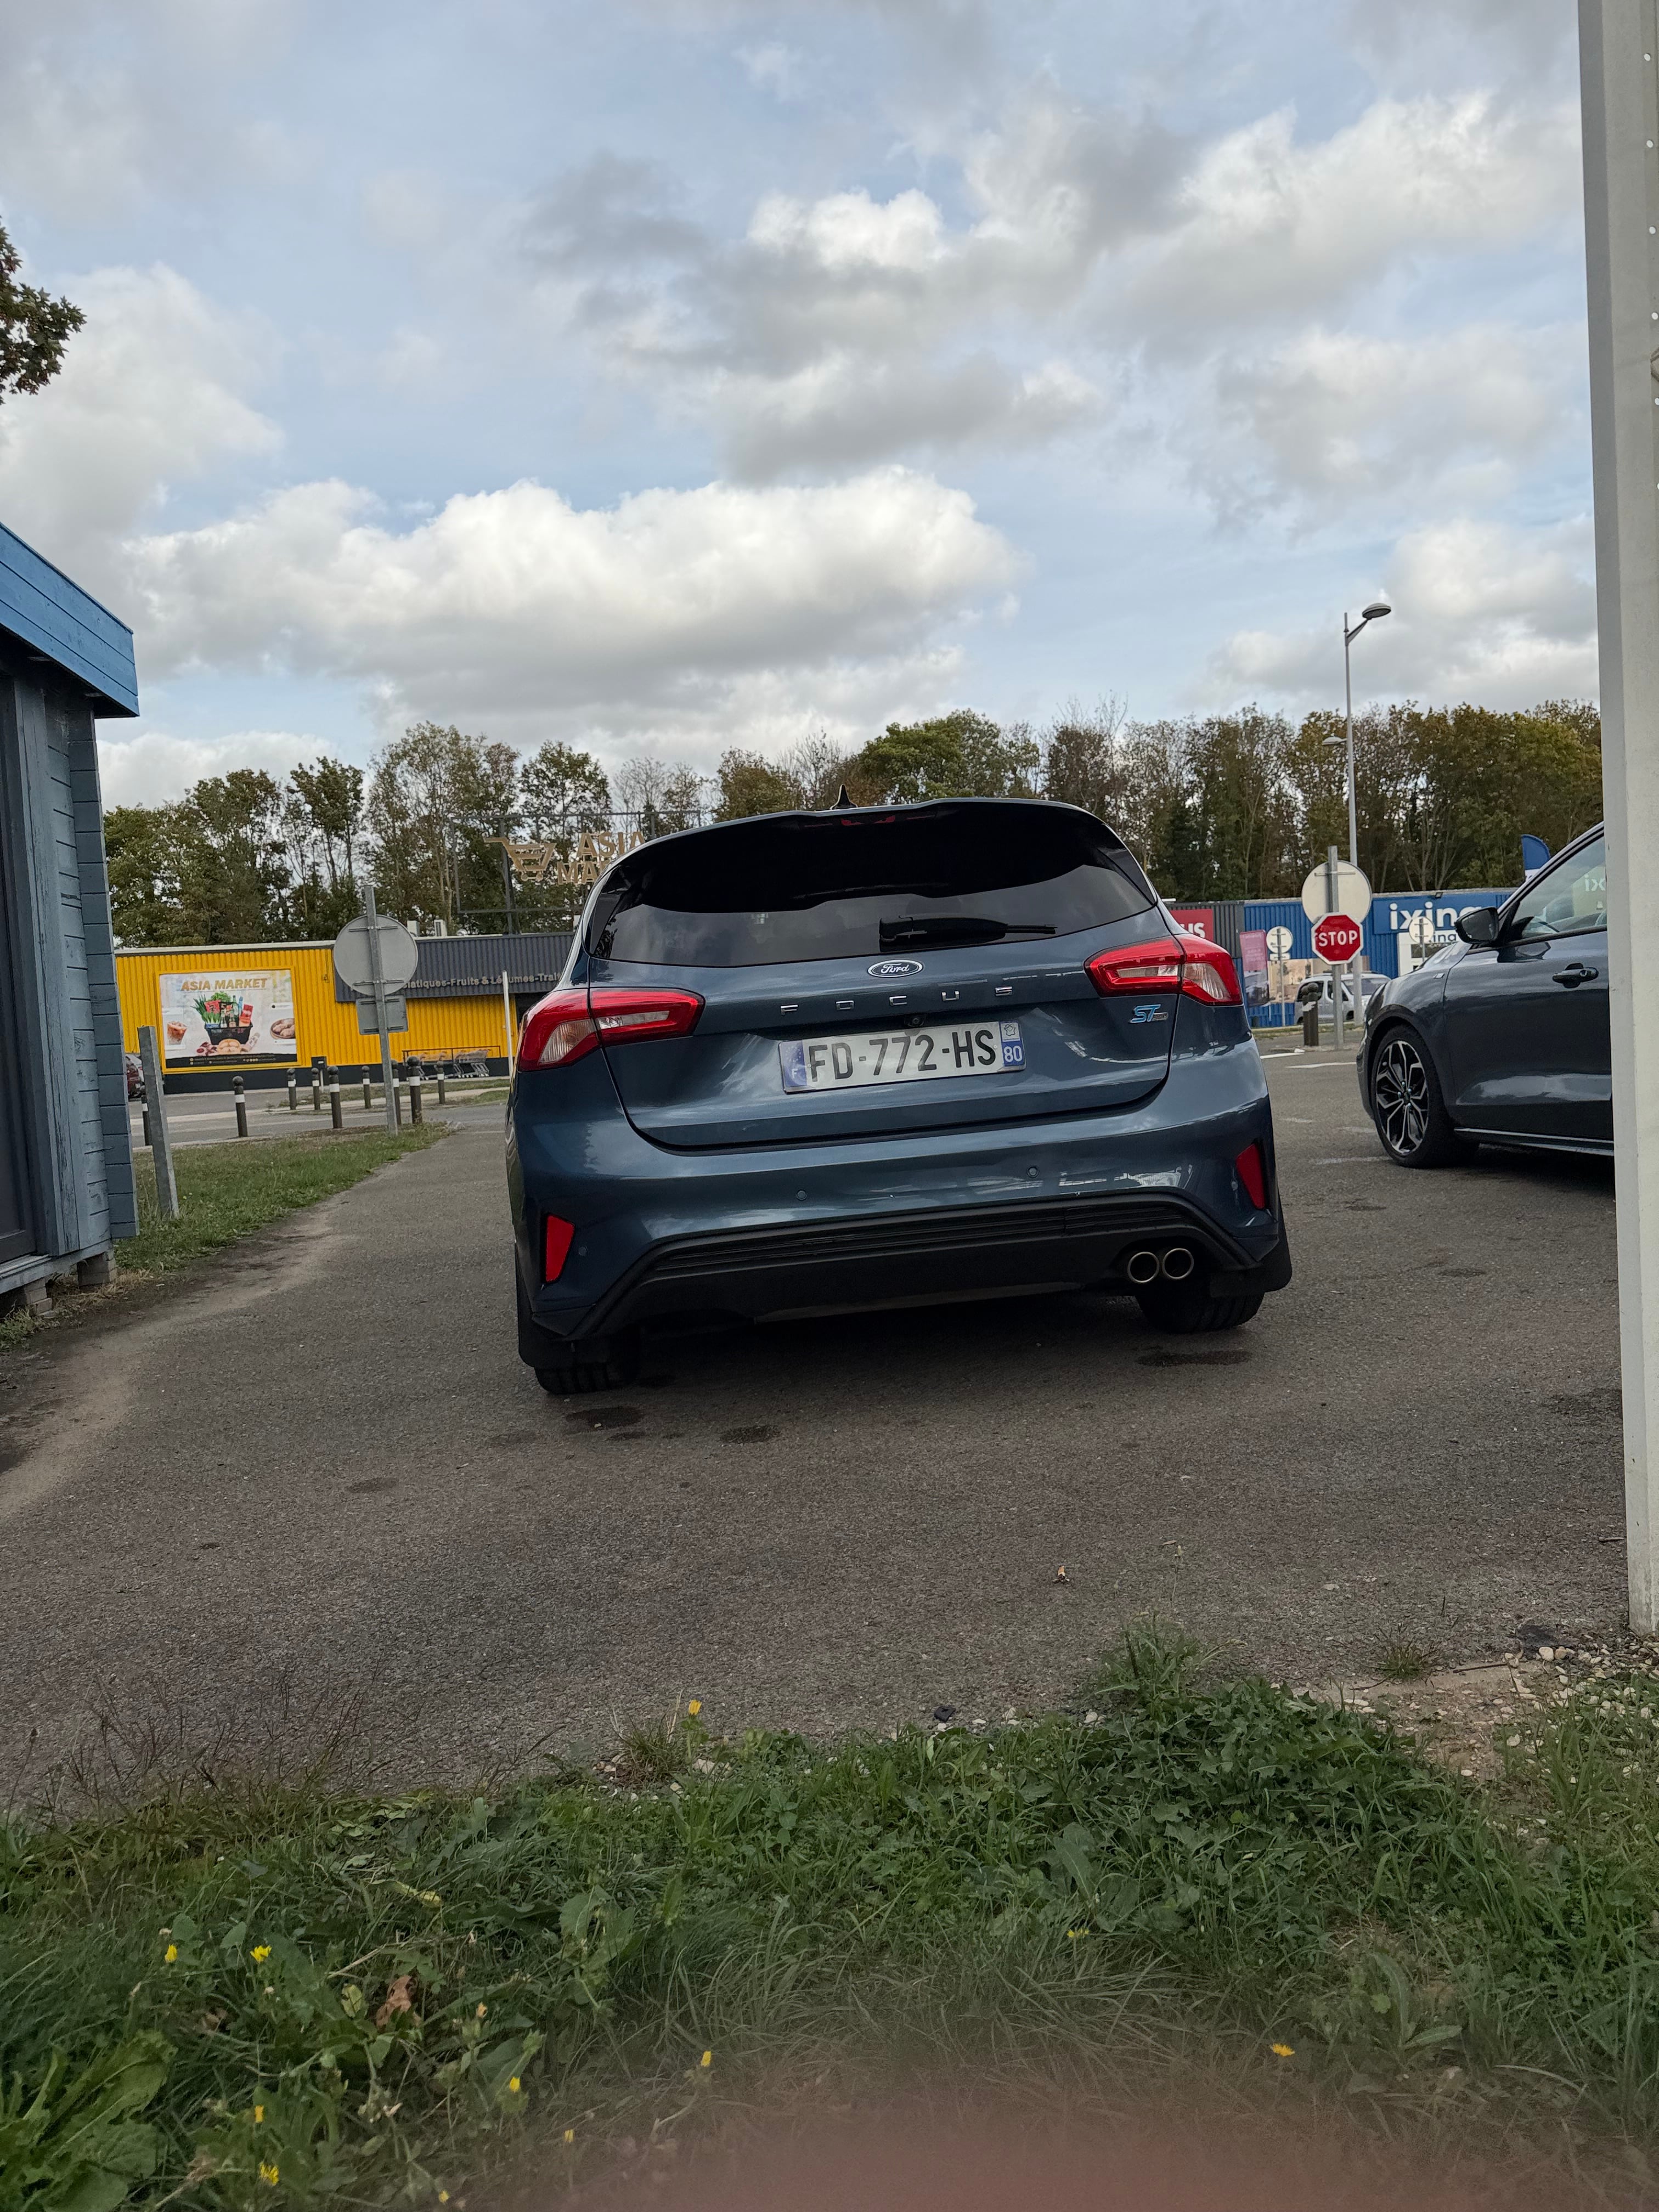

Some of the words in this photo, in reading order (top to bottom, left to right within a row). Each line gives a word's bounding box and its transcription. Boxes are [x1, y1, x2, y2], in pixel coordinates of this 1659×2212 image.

[576, 831, 645, 857] ASIA
[1390, 901, 1481, 930] ixin
[1318, 930, 1358, 947] STOP
[880, 963, 910, 974] Ford
[180, 980, 211, 991] ASIA
[215, 978, 268, 990] MARKET
[780, 986, 1013, 1015] FOCUS
[791, 1068, 798, 1079] F
[808, 1029, 996, 1082] FD-772-HS
[1003, 1045, 1023, 1063] 80
